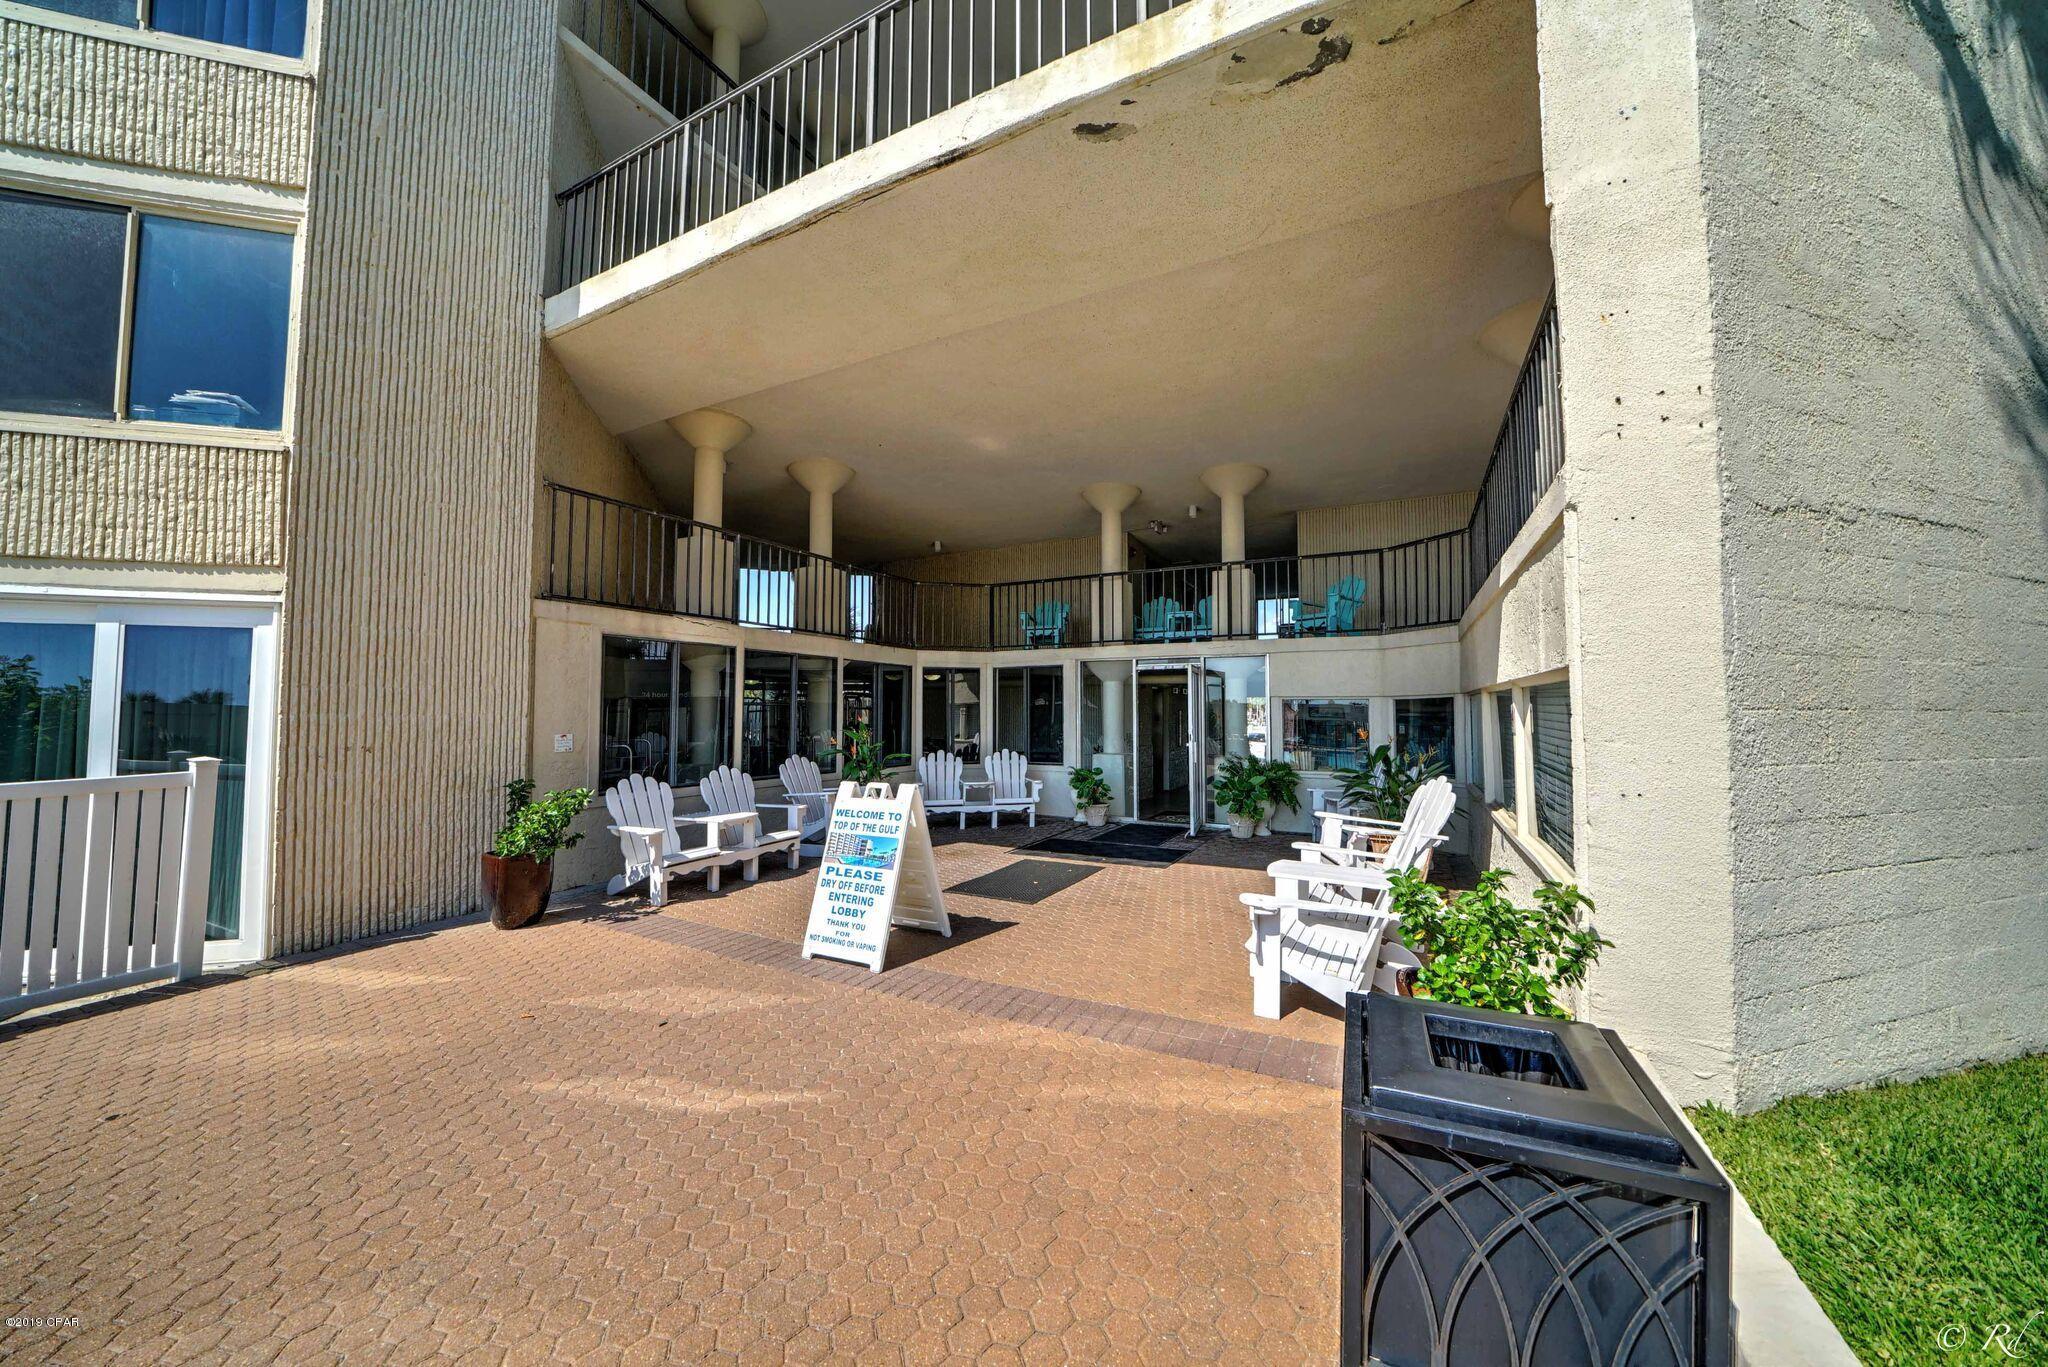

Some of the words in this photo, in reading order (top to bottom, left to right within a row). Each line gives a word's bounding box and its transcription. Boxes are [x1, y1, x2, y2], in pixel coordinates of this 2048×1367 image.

[836, 809, 885, 820] WELCOME
[888, 812, 902, 821] TO
[834, 821, 849, 830] TOP
[850, 822, 860, 831] OF
[862, 823, 877, 832] THE
[878, 824, 900, 834] GULF
[826, 866, 883, 881] PLEASE
[821, 879, 837, 888] DRY
[838, 880, 853, 890] OFF
[854, 882, 885, 895] BEFORE
[829, 891, 874, 907] ENTERING
[831, 905, 866, 919] LOBBY
[827, 918, 850, 928] THANK
[851, 921, 866, 931] YOU
[835, 930, 851, 938] FOR
[809, 933, 821, 941] NOT
[821, 935, 846, 947] SMOKING
[846, 940, 855, 948] OR
[855, 942, 877, 952] VAPING
